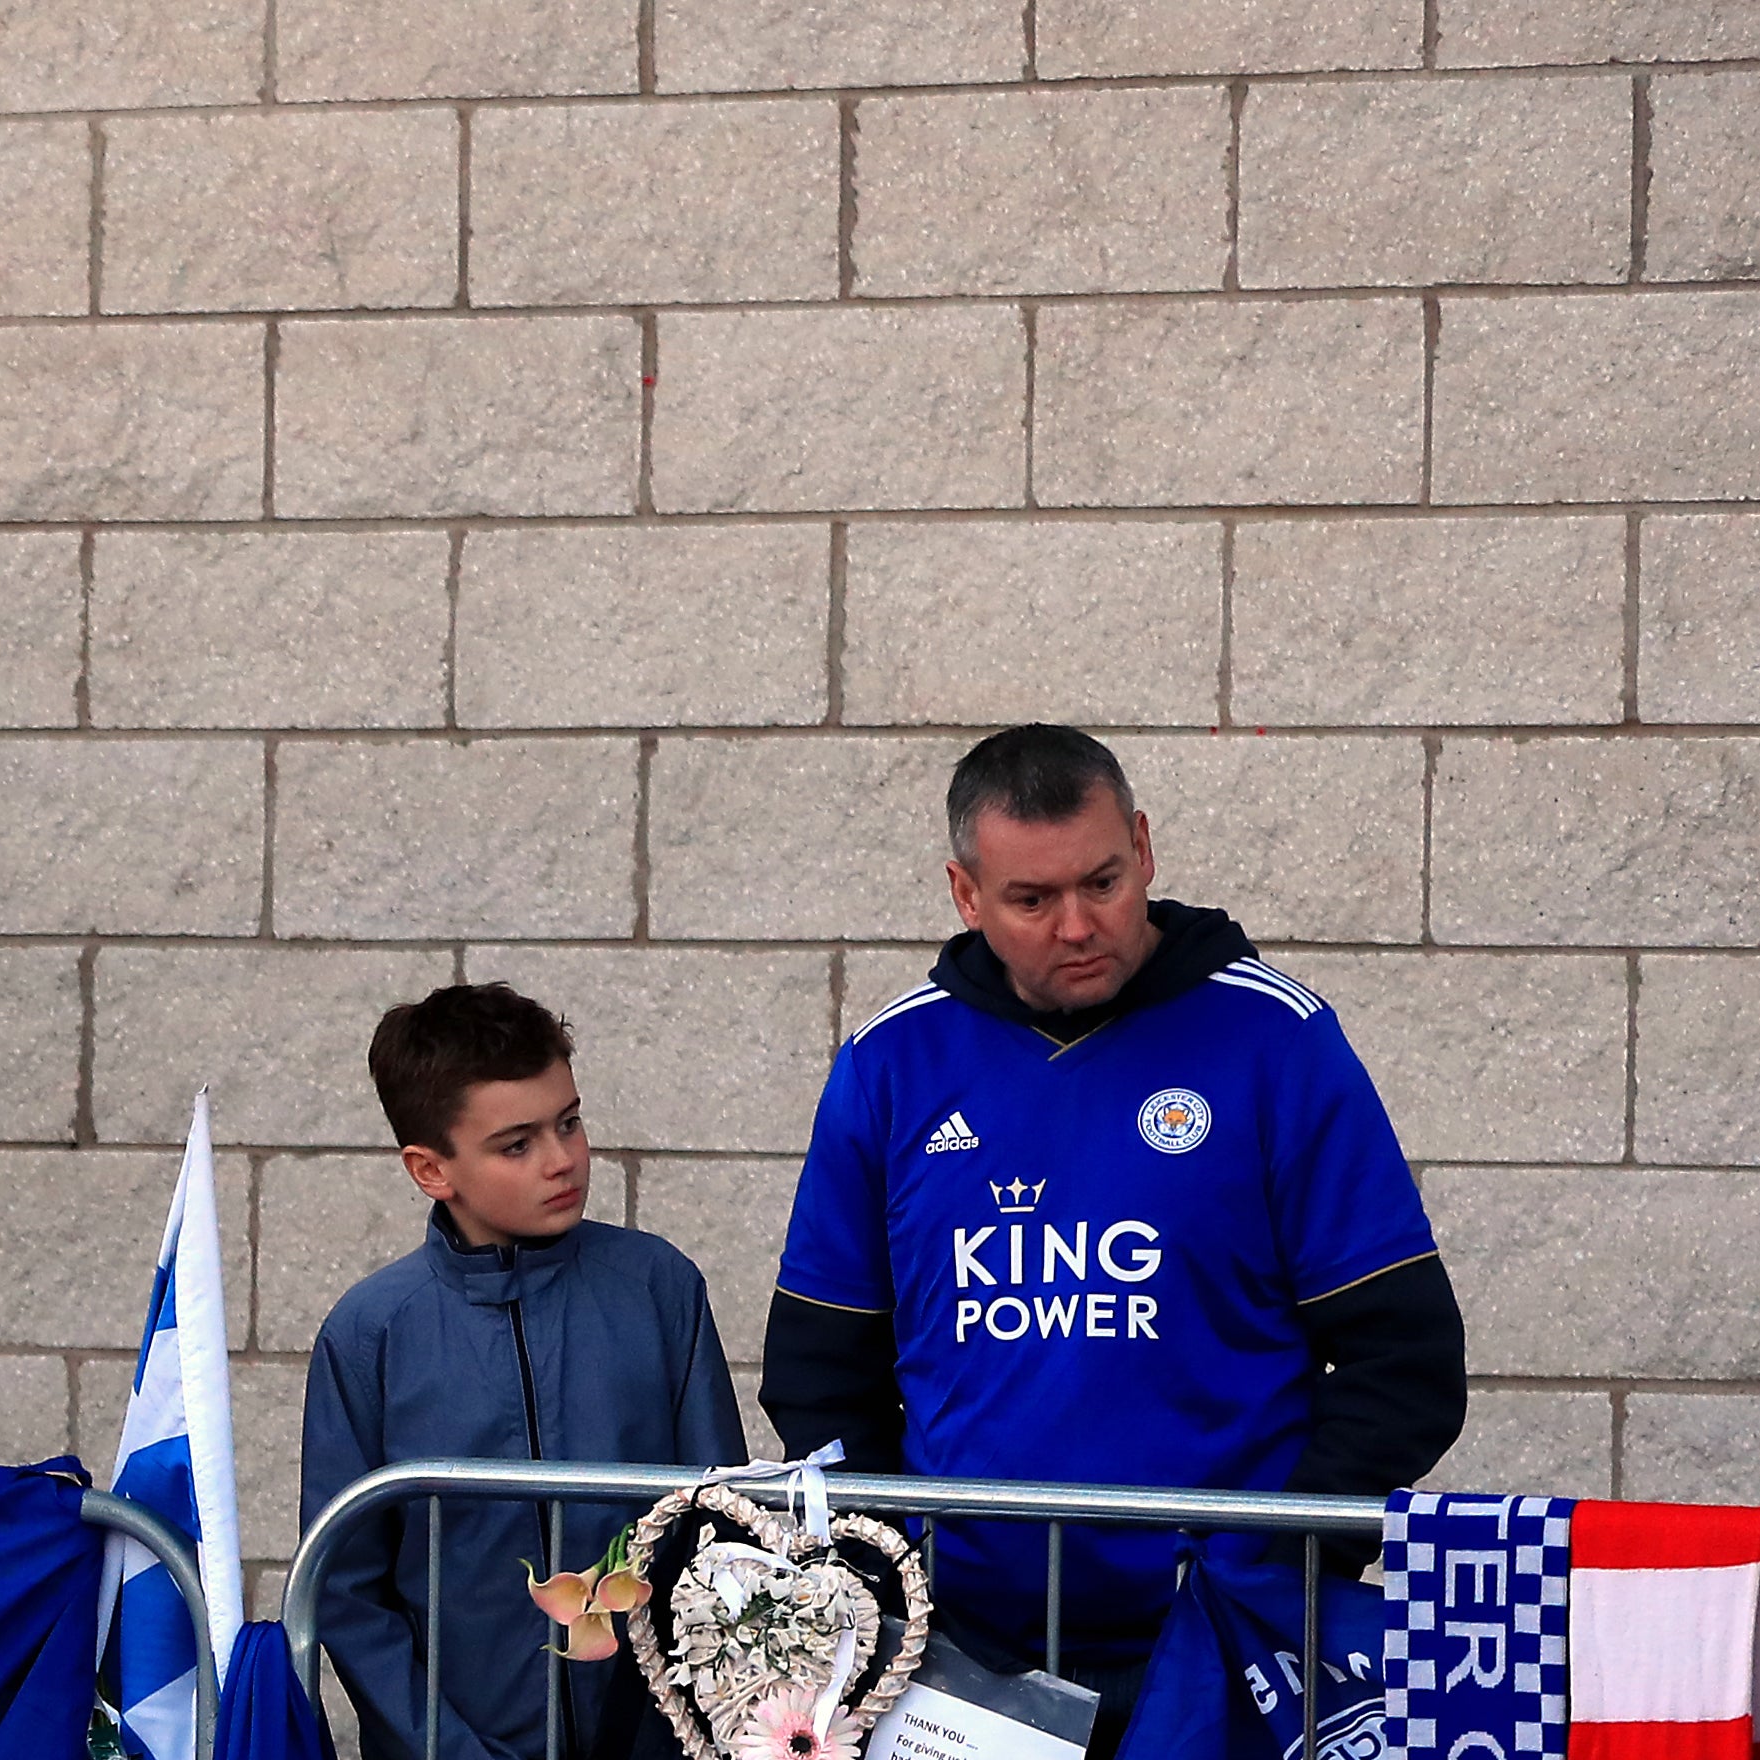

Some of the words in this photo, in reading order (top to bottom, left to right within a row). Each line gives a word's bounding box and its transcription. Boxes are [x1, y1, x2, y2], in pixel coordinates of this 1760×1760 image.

[925, 1136, 979, 1155] adidas
[1183, 1124, 1203, 1145] CLUB
[954, 1220, 1162, 1288] KING
[956, 1293, 1160, 1343] POWER
[895, 1733, 914, 1749] For
[903, 1712, 940, 1736] THANK
[941, 1727, 966, 1745] YOU
